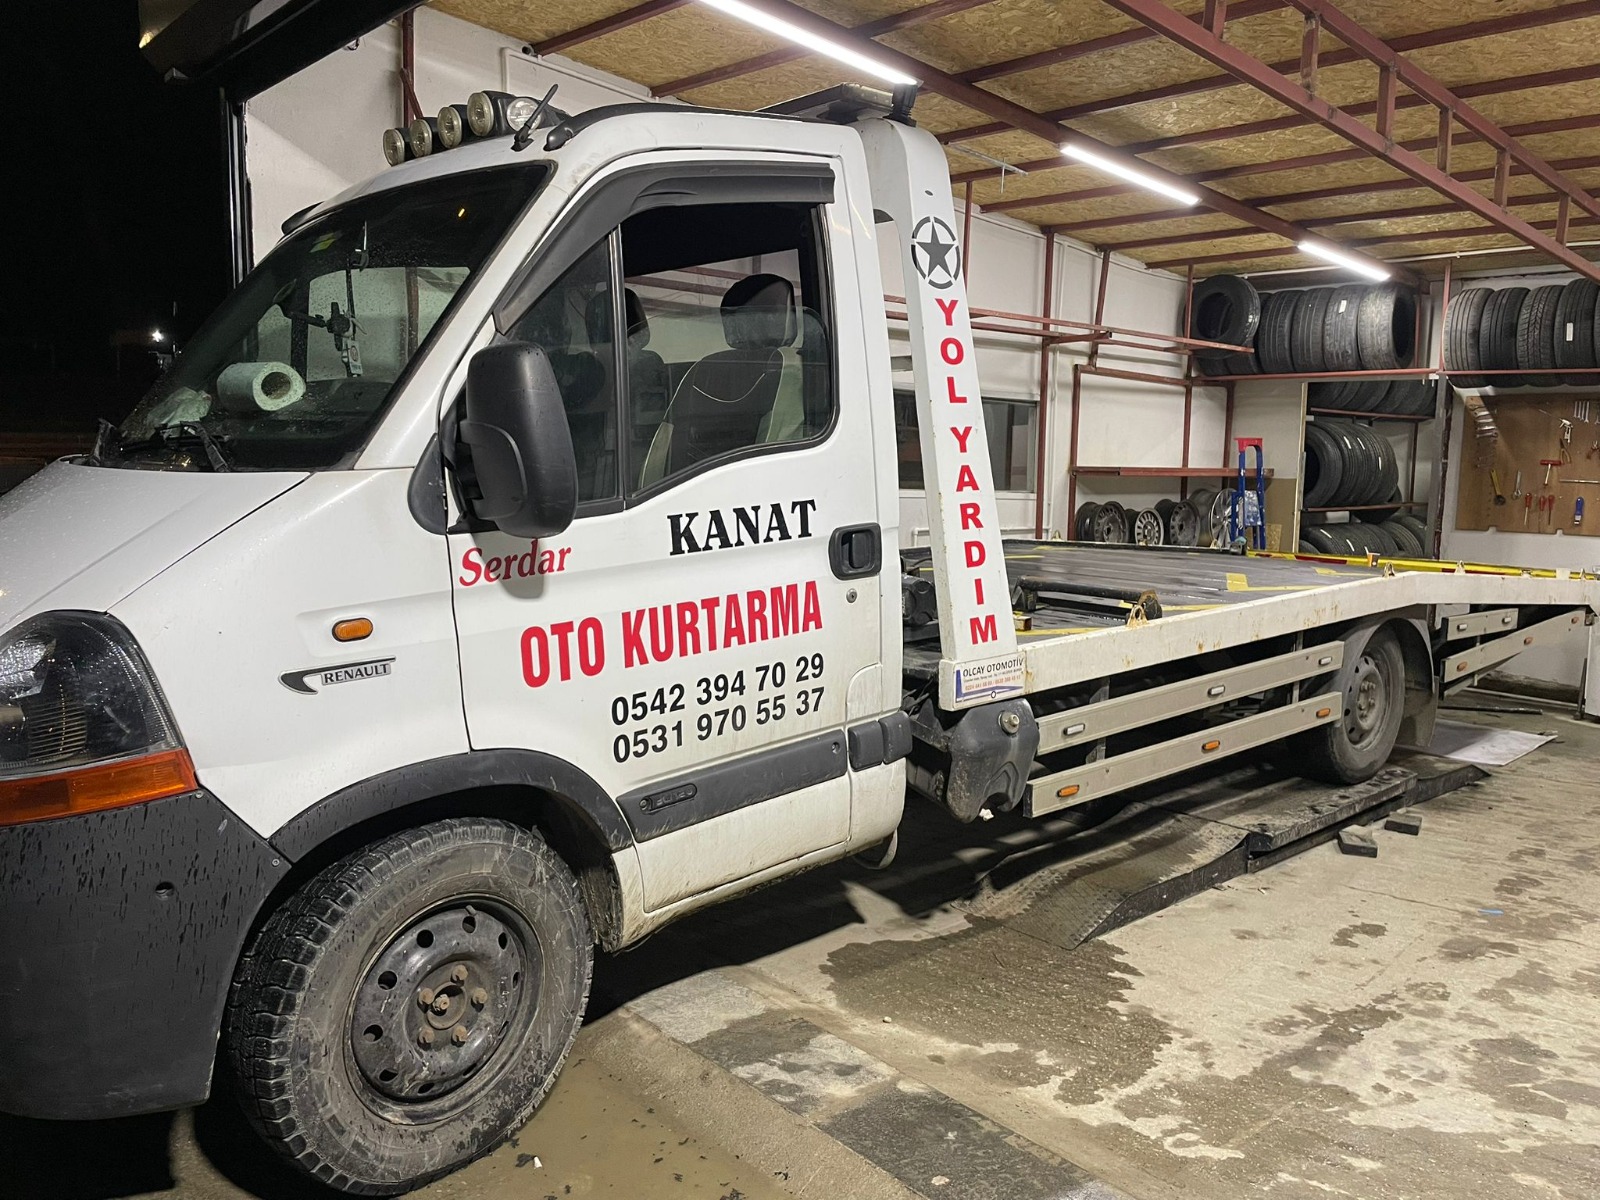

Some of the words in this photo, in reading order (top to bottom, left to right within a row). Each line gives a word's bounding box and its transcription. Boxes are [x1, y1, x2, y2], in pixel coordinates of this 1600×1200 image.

[667, 499, 816, 556] KANAT
[950, 426, 998, 645] YARDIM
[459, 539, 571, 586] Serdar
[520, 617, 605, 688] OTO
[621, 580, 823, 668] KURTARMA
[324, 663, 388, 684] RENAULT
[611, 684, 685, 726] 0542
[696, 669, 746, 706] 394
[755, 663, 786, 693] 70
[795, 652, 825, 683] 29
[963, 665, 985, 677] OLCAY
[986, 658, 1024, 672] OTOMOTİV
[613, 720, 684, 763] 0531
[697, 704, 747, 741] 970
[756, 695, 786, 725] 55
[795, 687, 825, 717] 37
